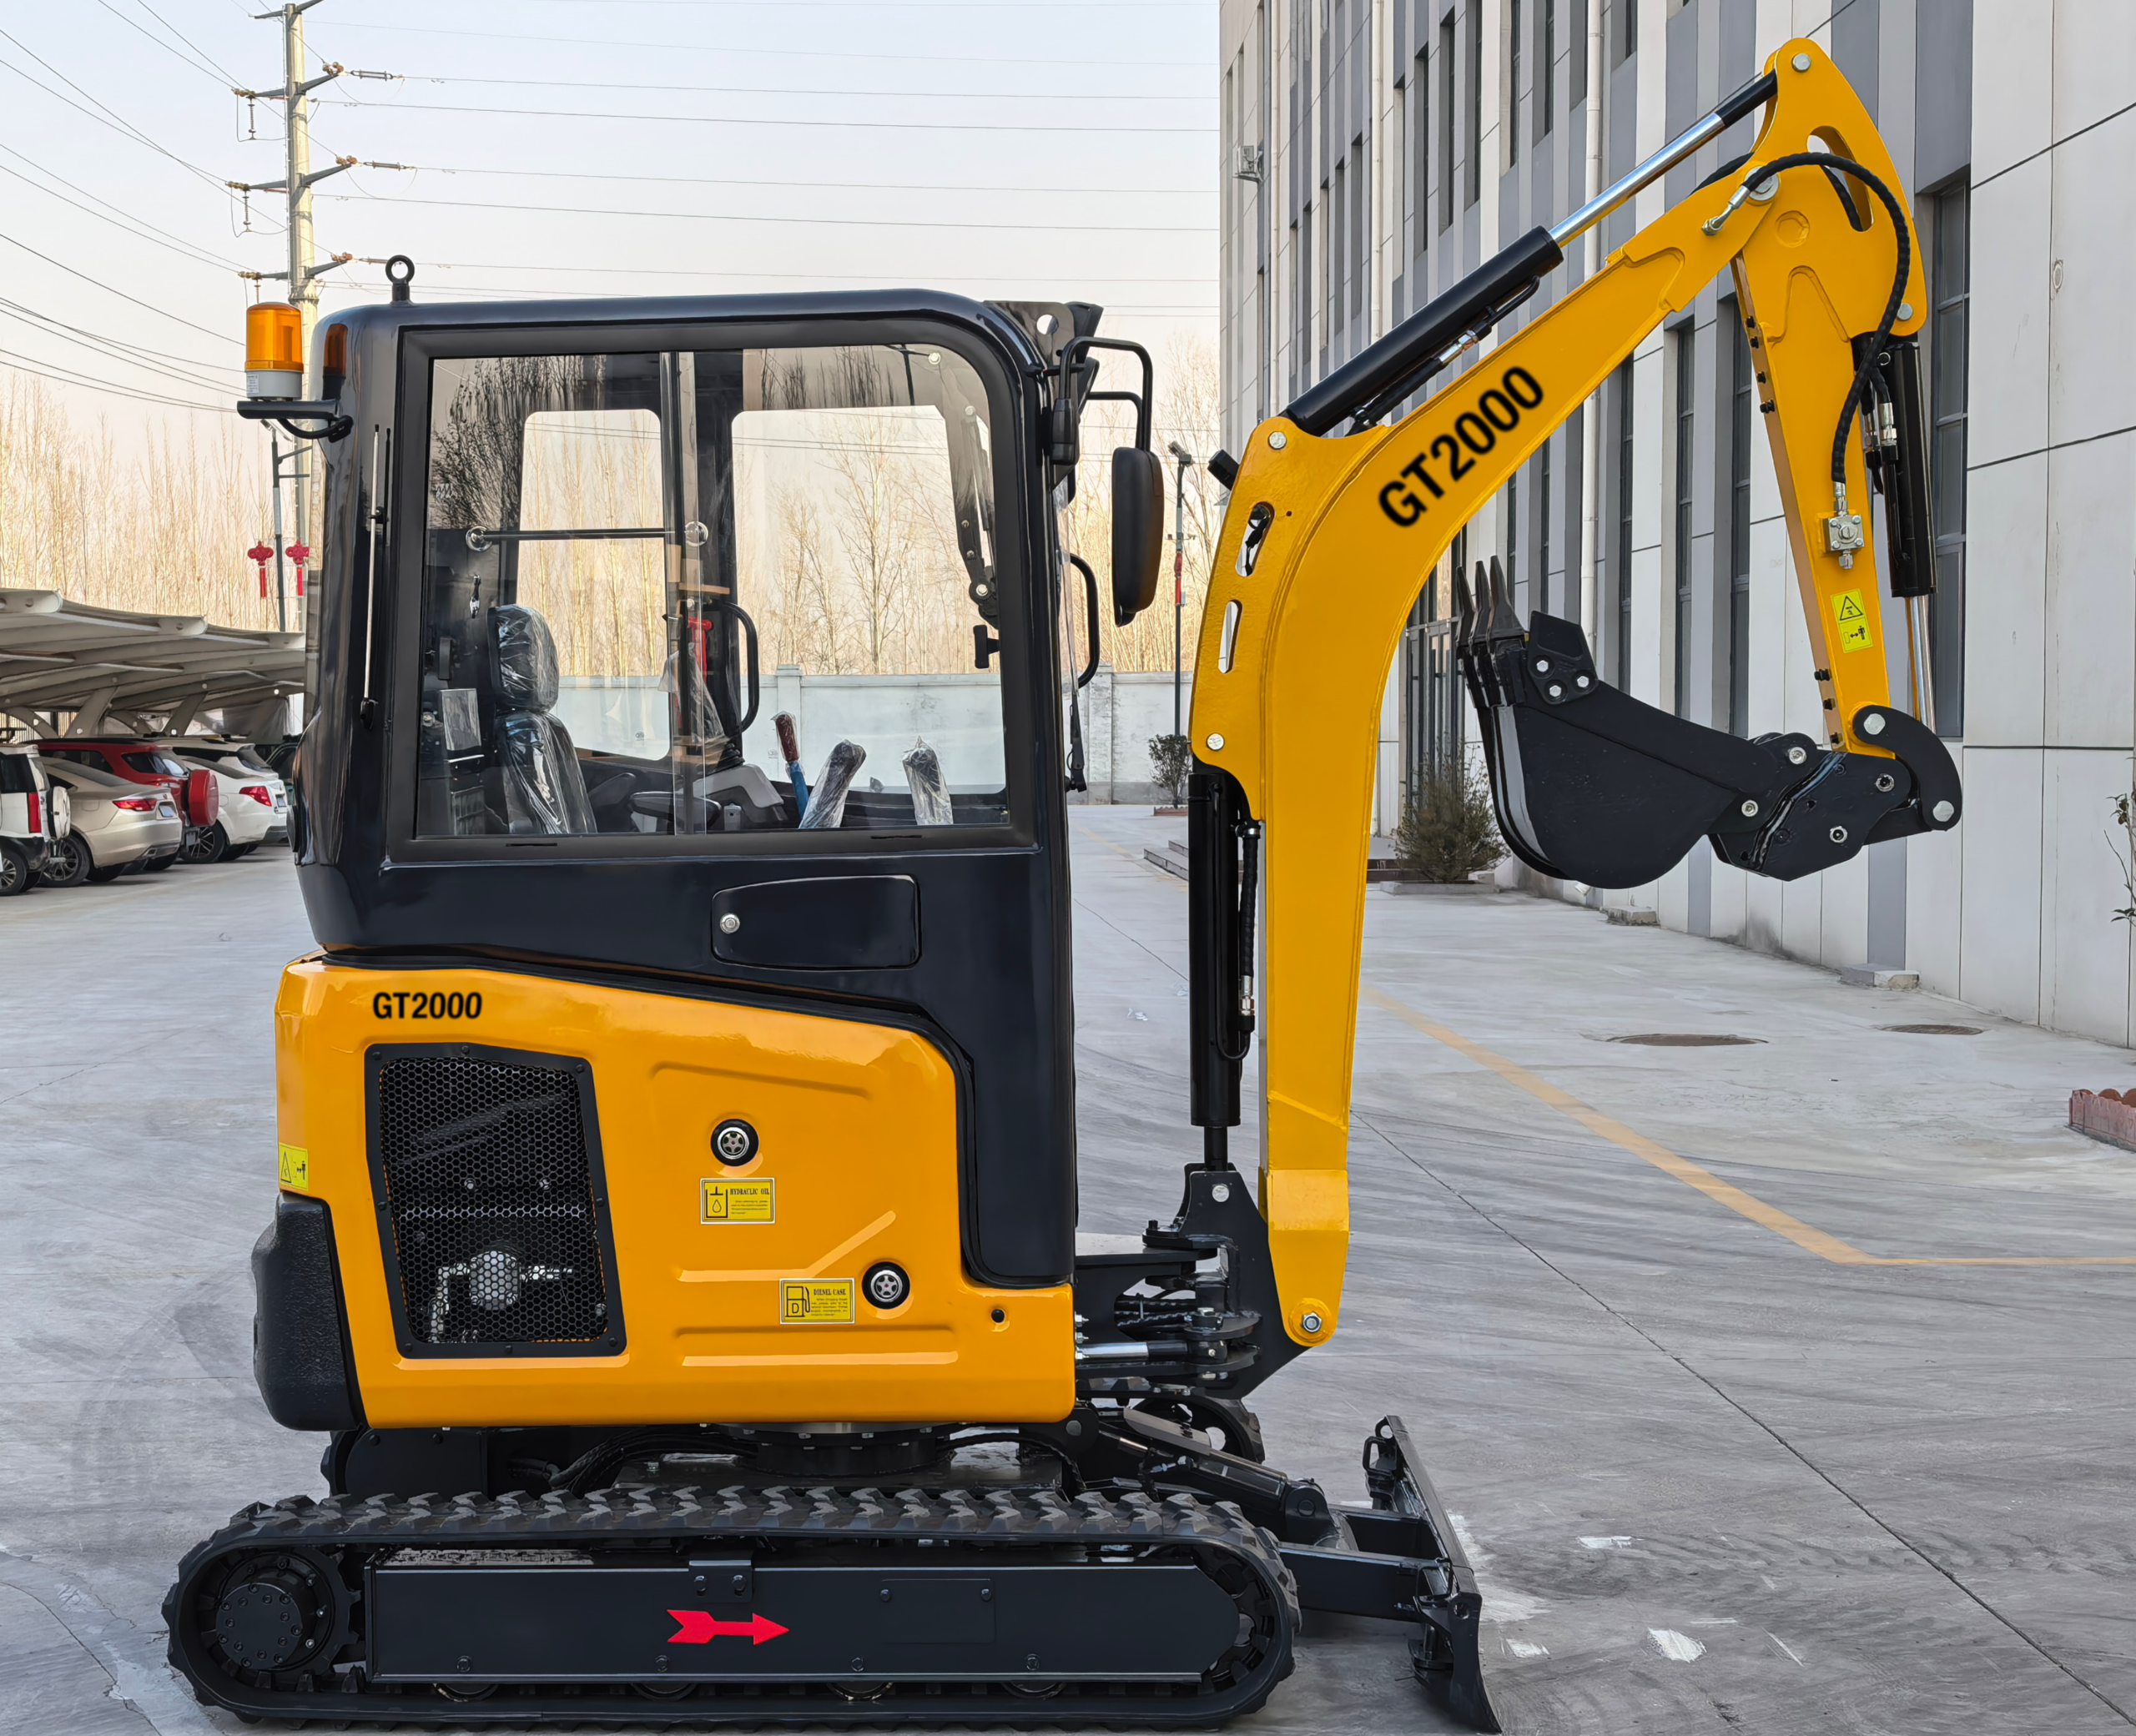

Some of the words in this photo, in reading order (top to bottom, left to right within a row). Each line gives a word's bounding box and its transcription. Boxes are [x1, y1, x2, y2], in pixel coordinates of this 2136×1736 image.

[1378, 366, 1544, 528] GT2000
[373, 992, 482, 1019] GT2000
[792, 1302, 799, 1314] D
